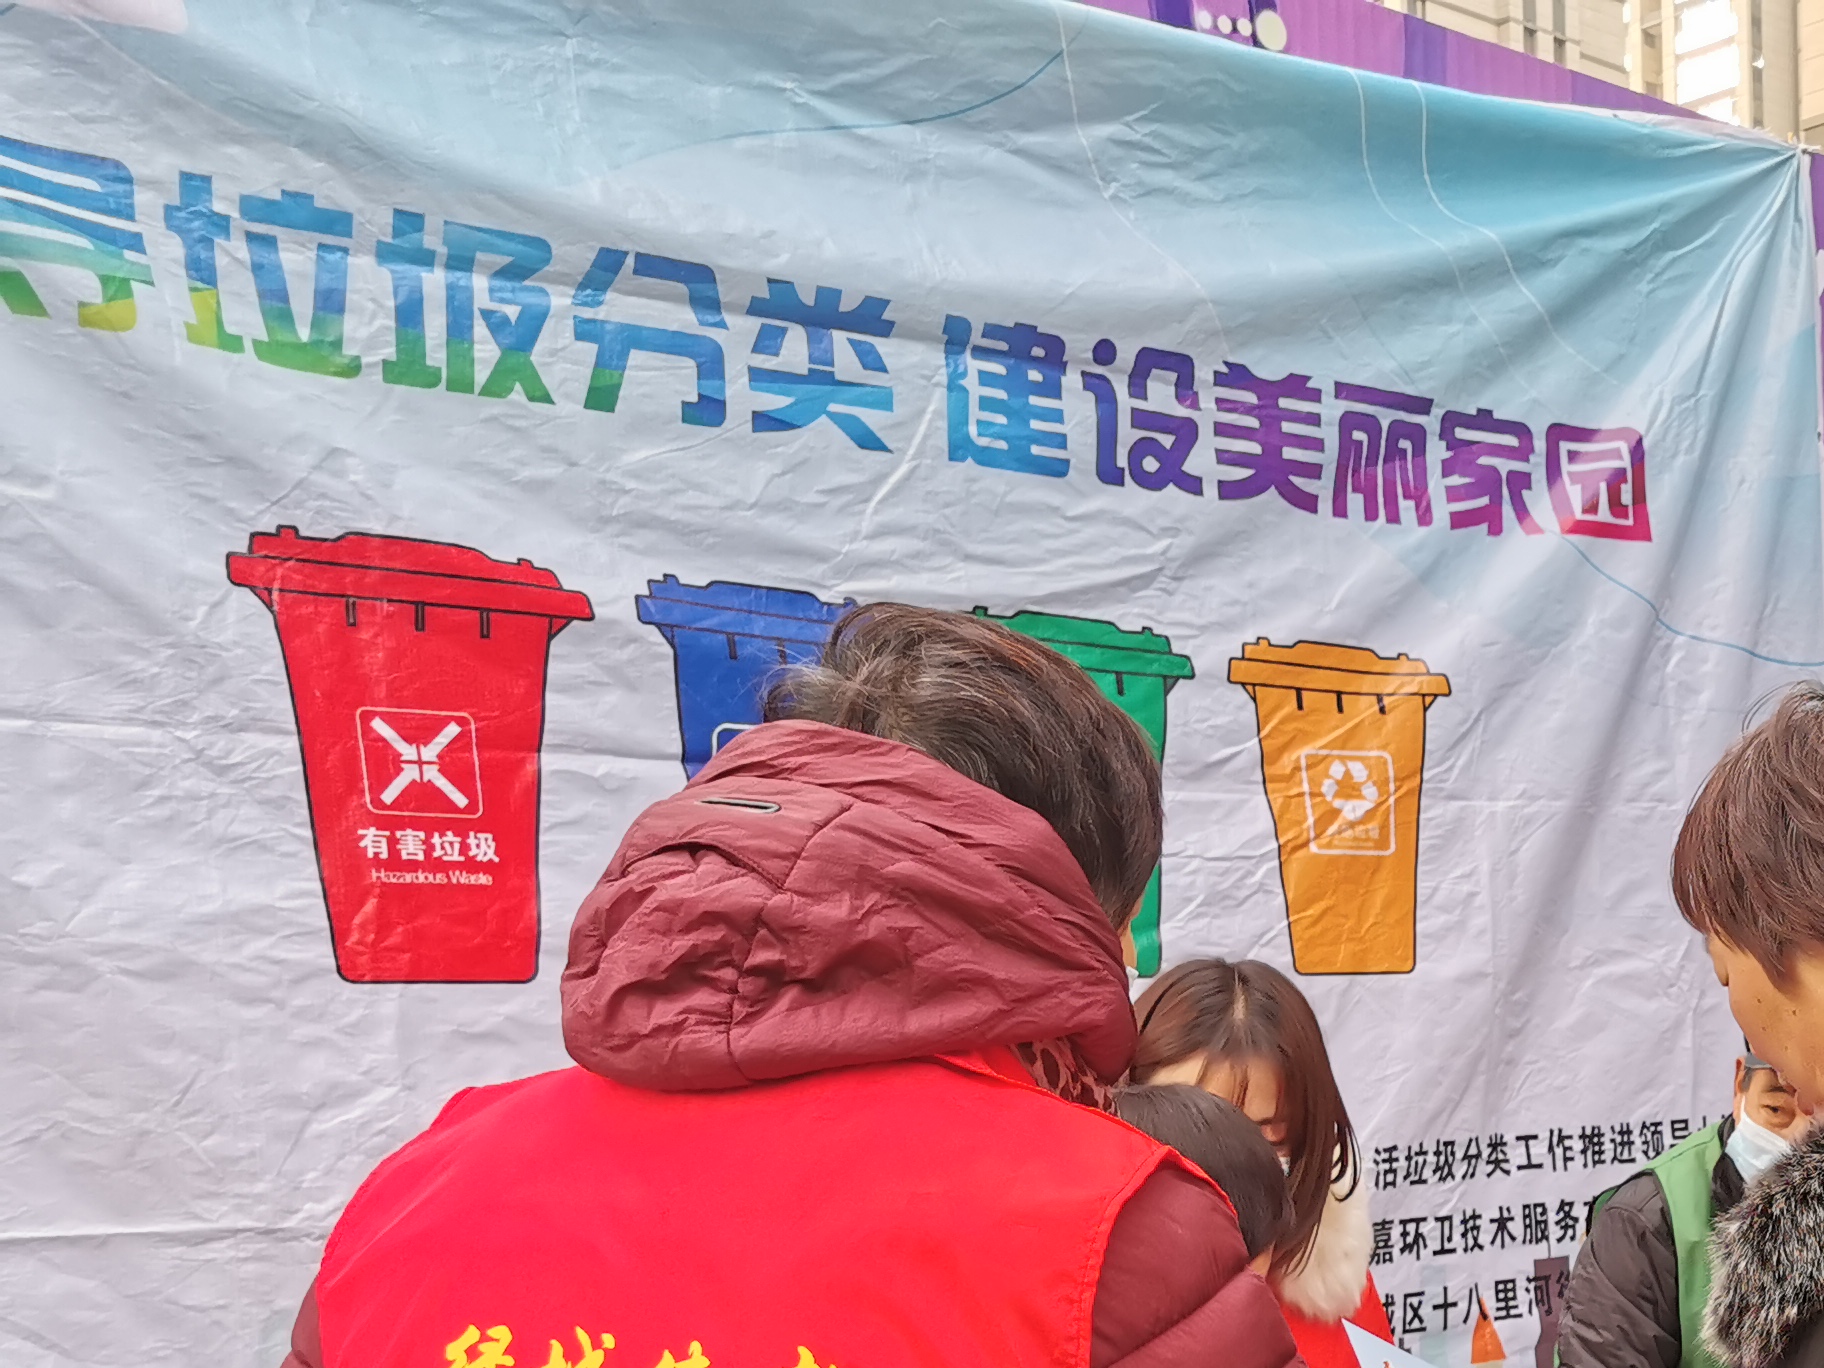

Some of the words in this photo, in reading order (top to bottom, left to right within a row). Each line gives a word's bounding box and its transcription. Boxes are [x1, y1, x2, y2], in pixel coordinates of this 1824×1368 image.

[942, 314, 1653, 543] 建设美丽家园
[357, 826, 500, 863] 有害垃圾
[371, 868, 448, 885] Hazardous
[449, 870, 493, 886] Waste
[1373, 1114, 1728, 1191] 活垃圾分类工作推进领导
[1369, 1196, 1595, 1266] 嘉环卫技术服务
